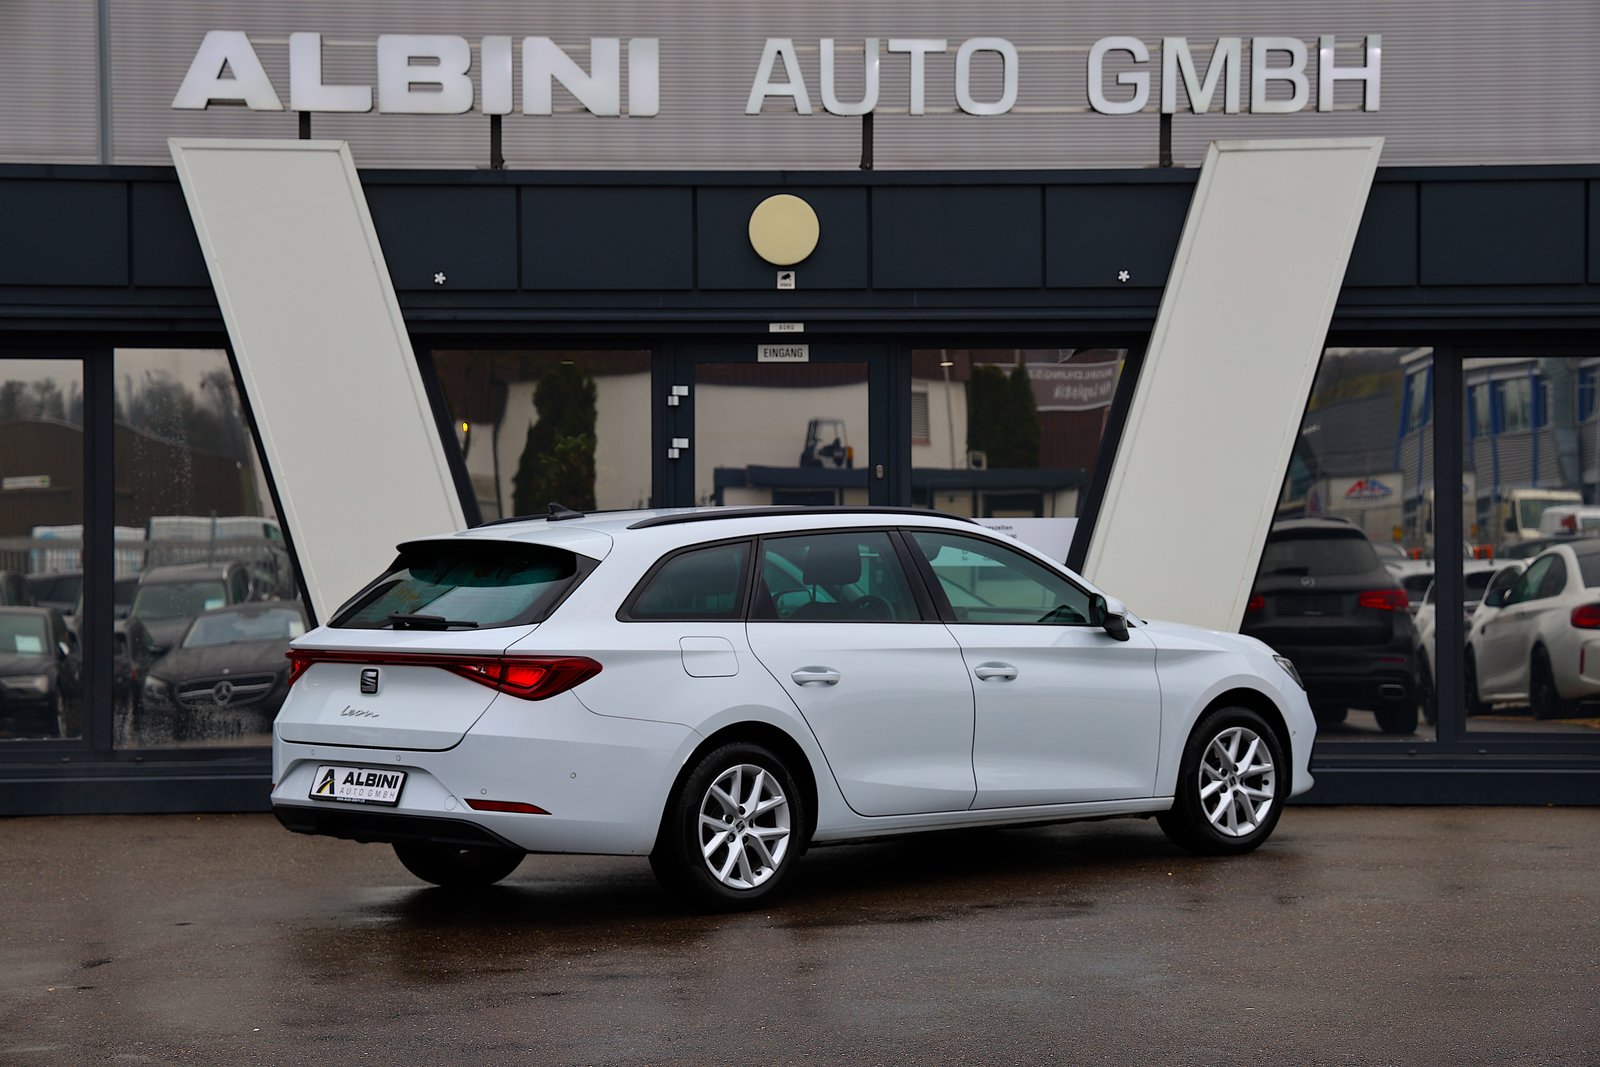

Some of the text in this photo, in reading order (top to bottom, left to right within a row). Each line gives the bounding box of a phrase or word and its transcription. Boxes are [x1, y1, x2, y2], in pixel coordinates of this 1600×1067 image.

[171, 30, 1382, 117] ALBINI AUTO GMBH
[763, 348, 803, 357] EINGANG
[340, 705, 379, 718] Leon
[342, 771, 400, 789] ALBINI
[340, 787, 395, 798] AUTO GMBH
